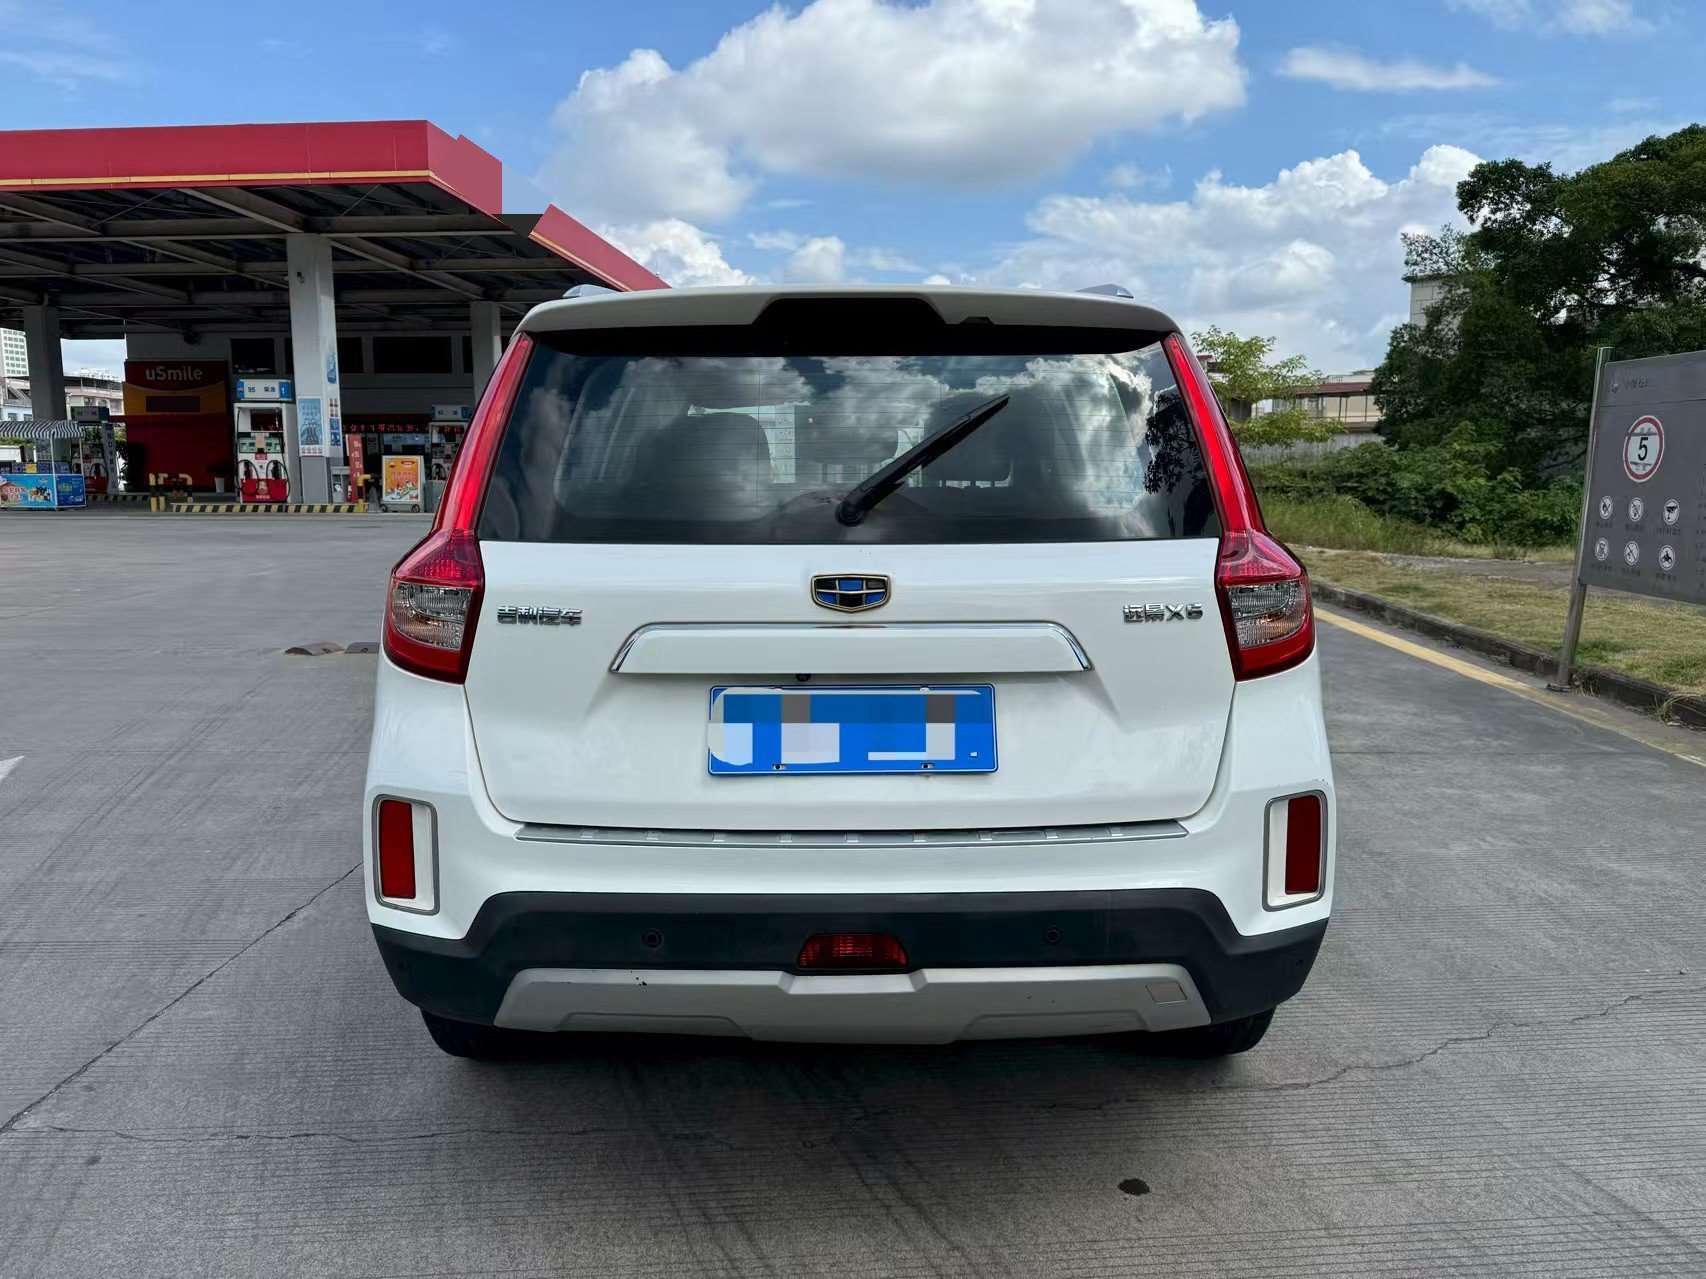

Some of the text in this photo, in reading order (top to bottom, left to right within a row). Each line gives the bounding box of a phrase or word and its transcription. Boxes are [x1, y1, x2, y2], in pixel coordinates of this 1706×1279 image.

[145, 366, 203, 381] uSmile
[1637, 436, 1649, 461] 5
[497, 606, 582, 626] 吉利汽车
[1123, 603, 1204, 624] 远景X6
